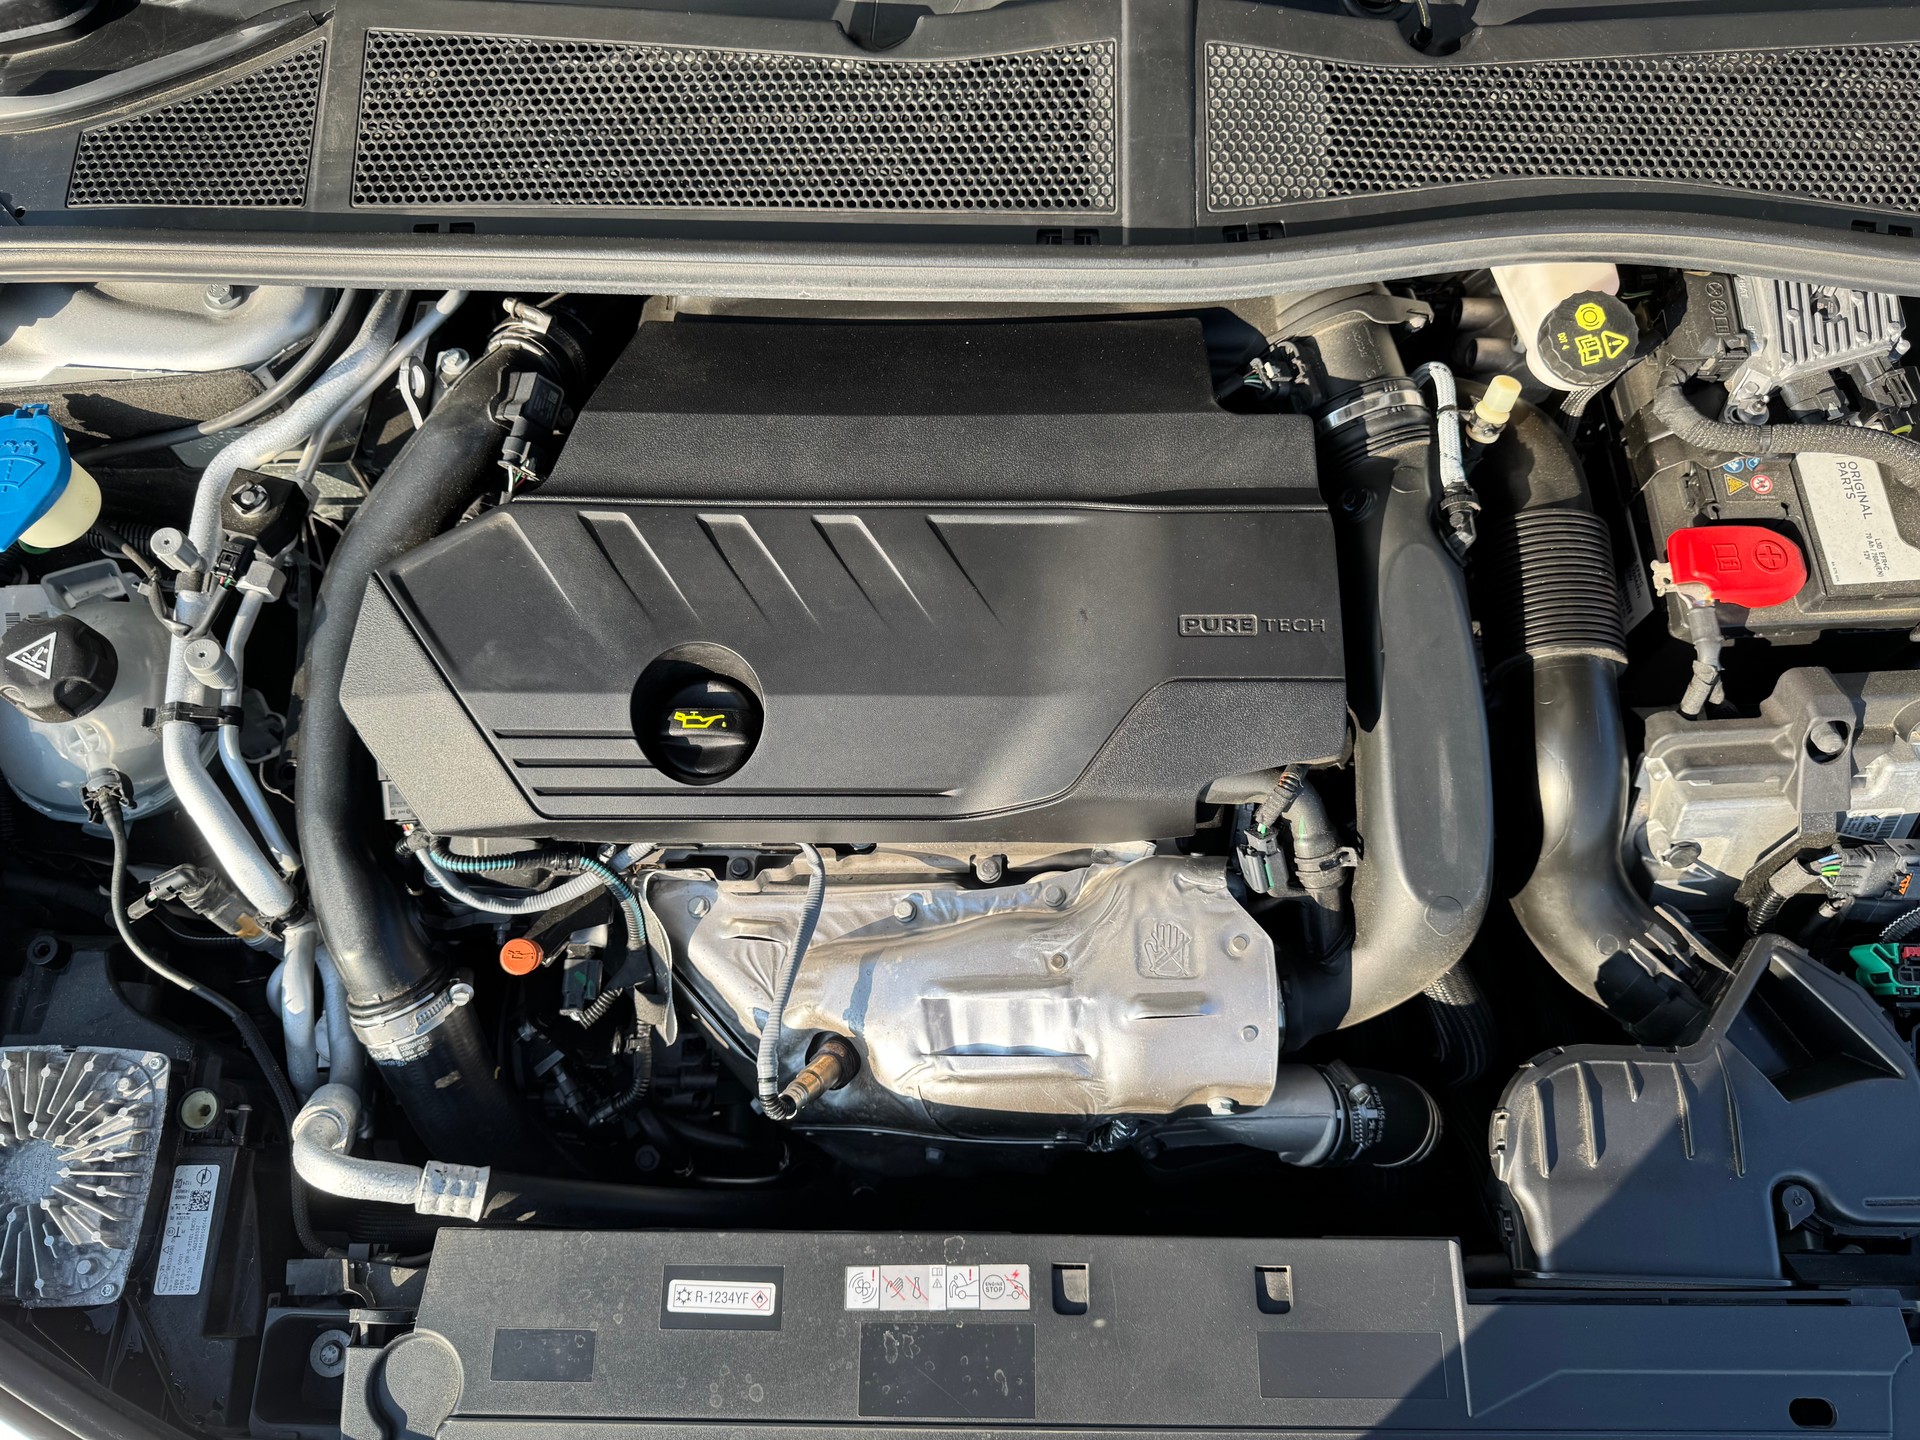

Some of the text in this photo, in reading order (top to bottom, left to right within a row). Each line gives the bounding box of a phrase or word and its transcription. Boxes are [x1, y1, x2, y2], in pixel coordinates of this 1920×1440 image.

[1557, 332, 1568, 344] DOT
[1836, 462, 1856, 499] PARTS
[1847, 461, 1873, 520] ORIGINAL
[1863, 550, 1872, 560] 12V
[1182, 617, 1326, 634] PURE TECH
[695, 1290, 749, 1304] R-1234YF
